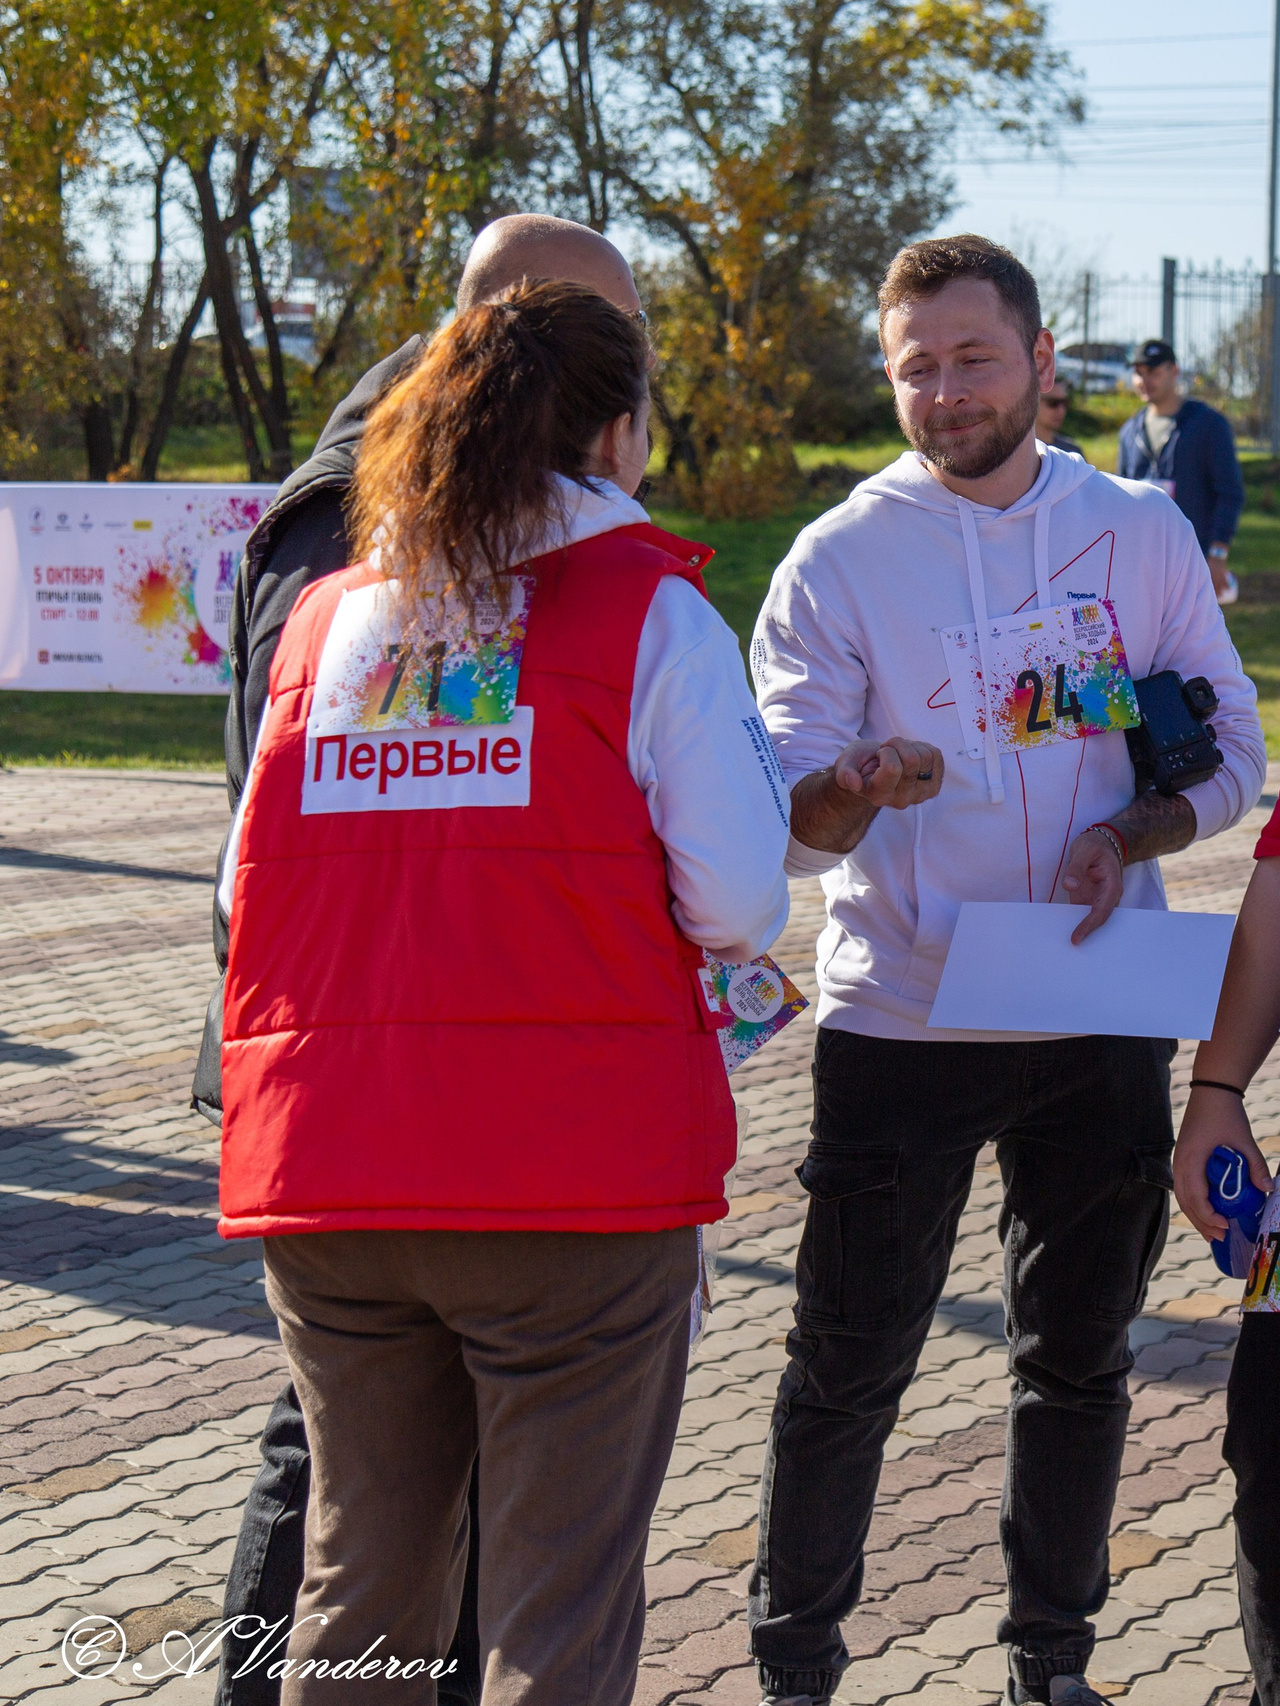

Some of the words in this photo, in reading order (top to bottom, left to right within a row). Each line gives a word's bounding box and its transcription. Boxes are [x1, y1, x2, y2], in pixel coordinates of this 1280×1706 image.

[33, 567, 42, 585] 5
[46, 567, 104, 585] ОКТЯБРЯ
[1067, 591, 1097, 601] Первые
[1087, 638, 1099, 646] 2024
[1014, 663, 1084, 733] 24
[741, 717, 761, 753] детей
[759, 715, 786, 784] оссийское
[313, 734, 521, 795] Первые
[757, 754, 765, 763] и
[760, 765, 790, 828] молодёжи
[733, 984, 747, 999] ДЕНЬ
[744, 996, 762, 1016] ХОДЬБЫ
[736, 999, 748, 1012] 2024
[738, 981, 767, 1011] ВСЕРОССИЙСКИЙ
